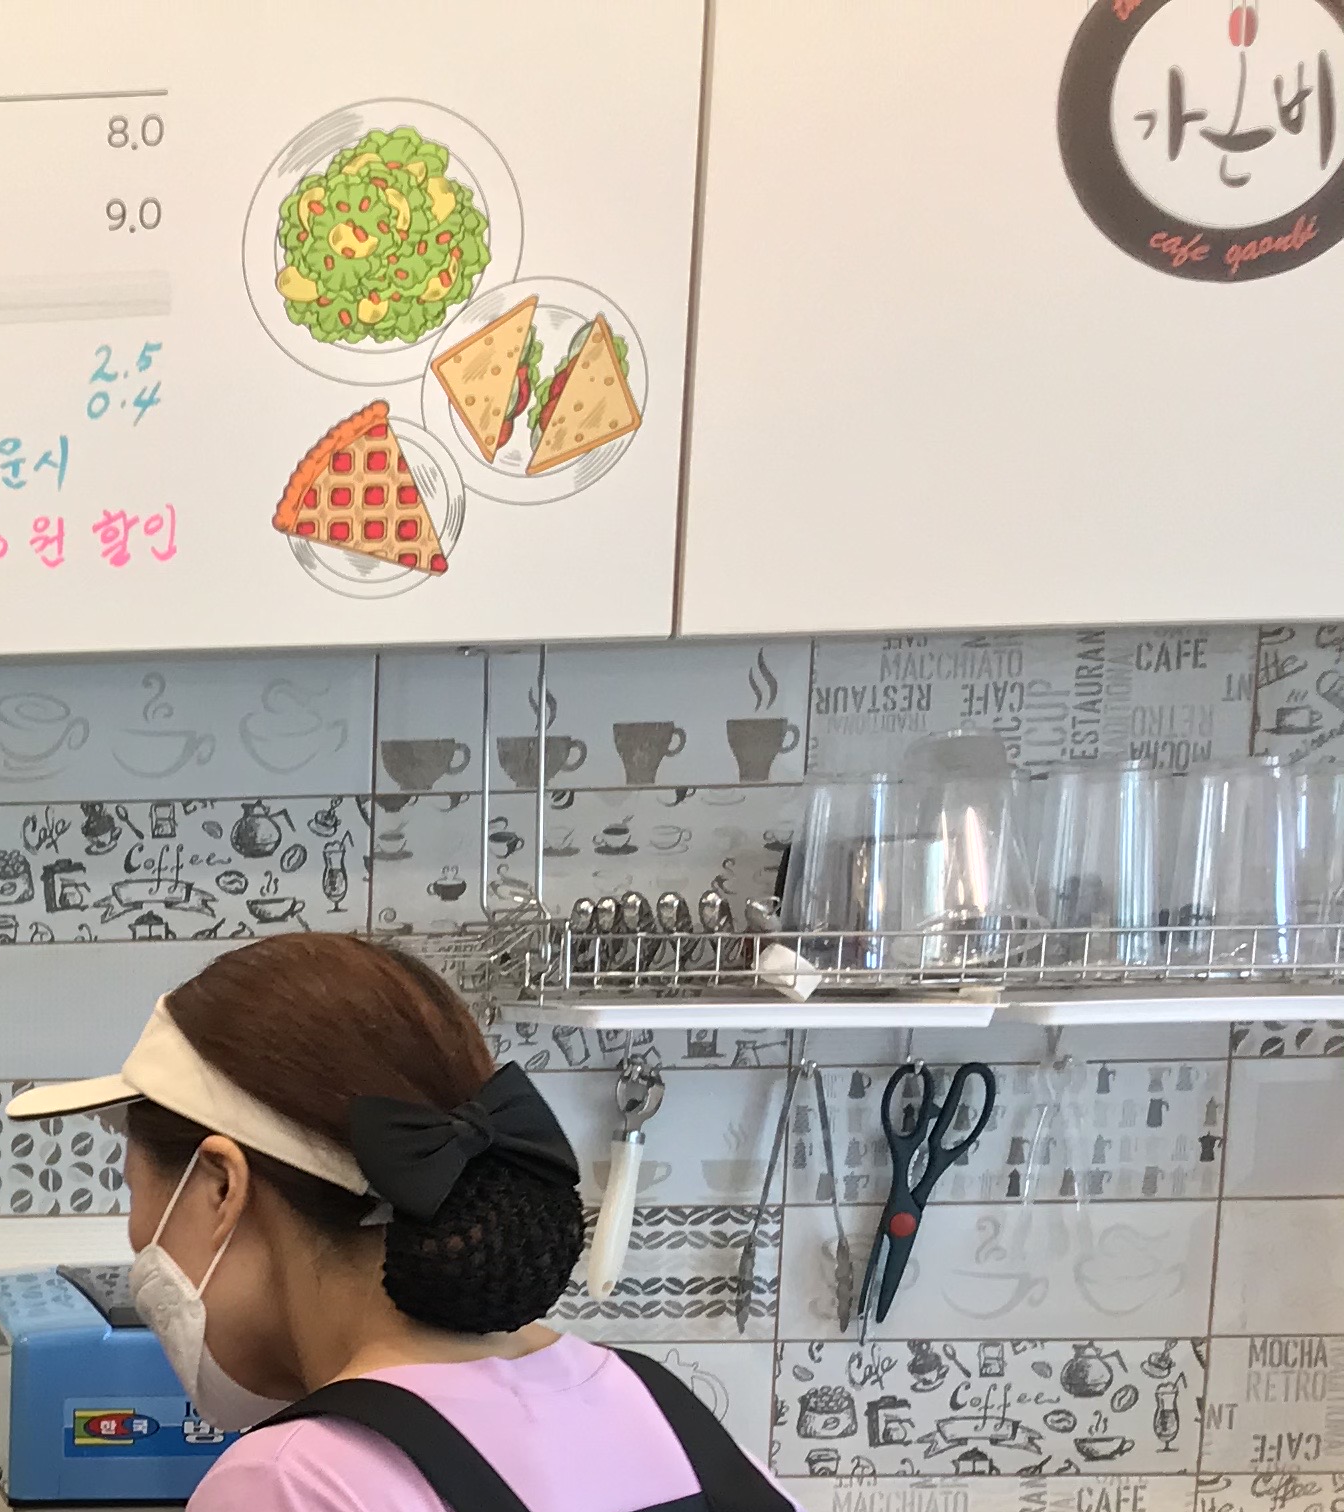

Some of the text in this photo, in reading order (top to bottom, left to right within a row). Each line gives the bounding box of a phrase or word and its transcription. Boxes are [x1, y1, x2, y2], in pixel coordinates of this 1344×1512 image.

[108, 114, 164, 150] 8.0
[106, 198, 161, 233] 9.0
[1135, 638, 1208, 672] CAFE
[123, 843, 233, 896] Coffee
[1248, 1337, 1328, 1369] MOCHA
[1246, 1370, 1328, 1403] RETRO
[949, 1381, 1061, 1432] Coffee
